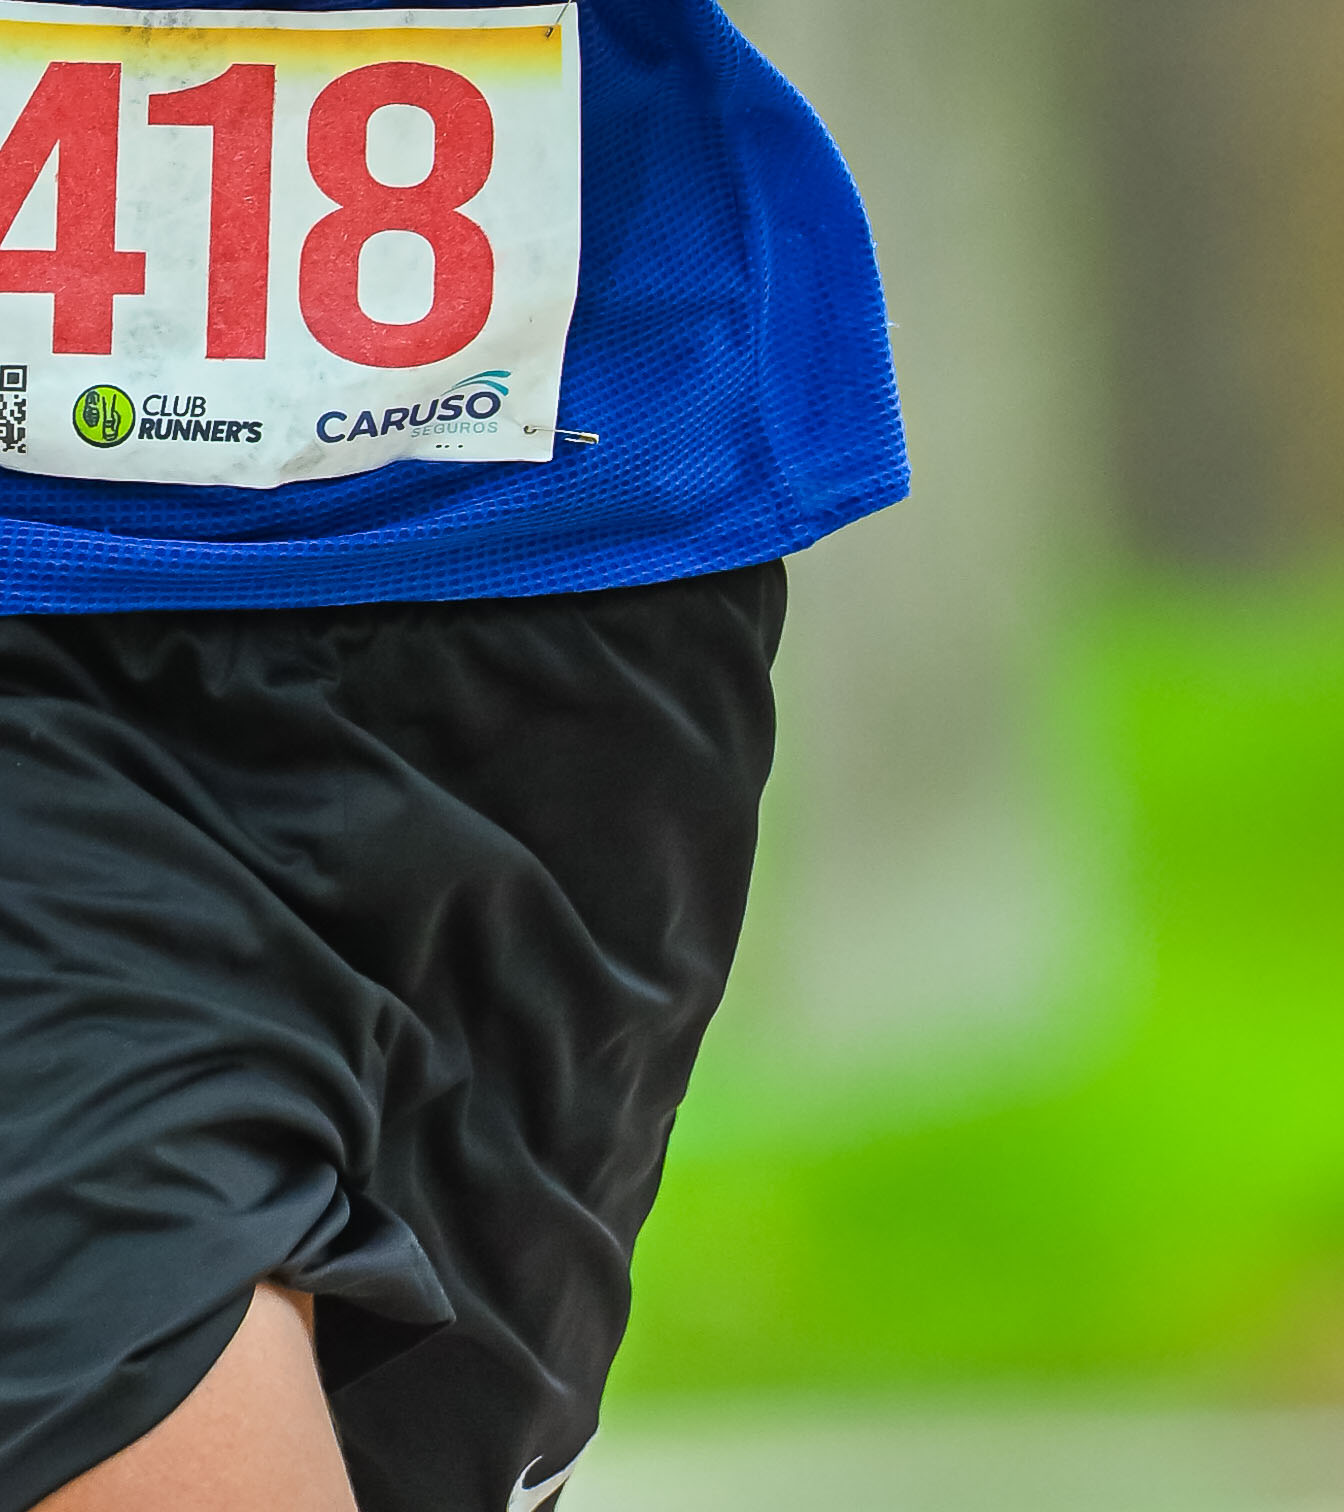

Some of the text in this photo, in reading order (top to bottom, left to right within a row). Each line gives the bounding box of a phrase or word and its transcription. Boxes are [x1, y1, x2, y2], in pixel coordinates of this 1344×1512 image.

[142, 394, 207, 417] CLUB
[316, 391, 501, 444] CARUSO
[138, 417, 264, 443] RUNNER'S
[410, 421, 498, 438] SEGUROS
